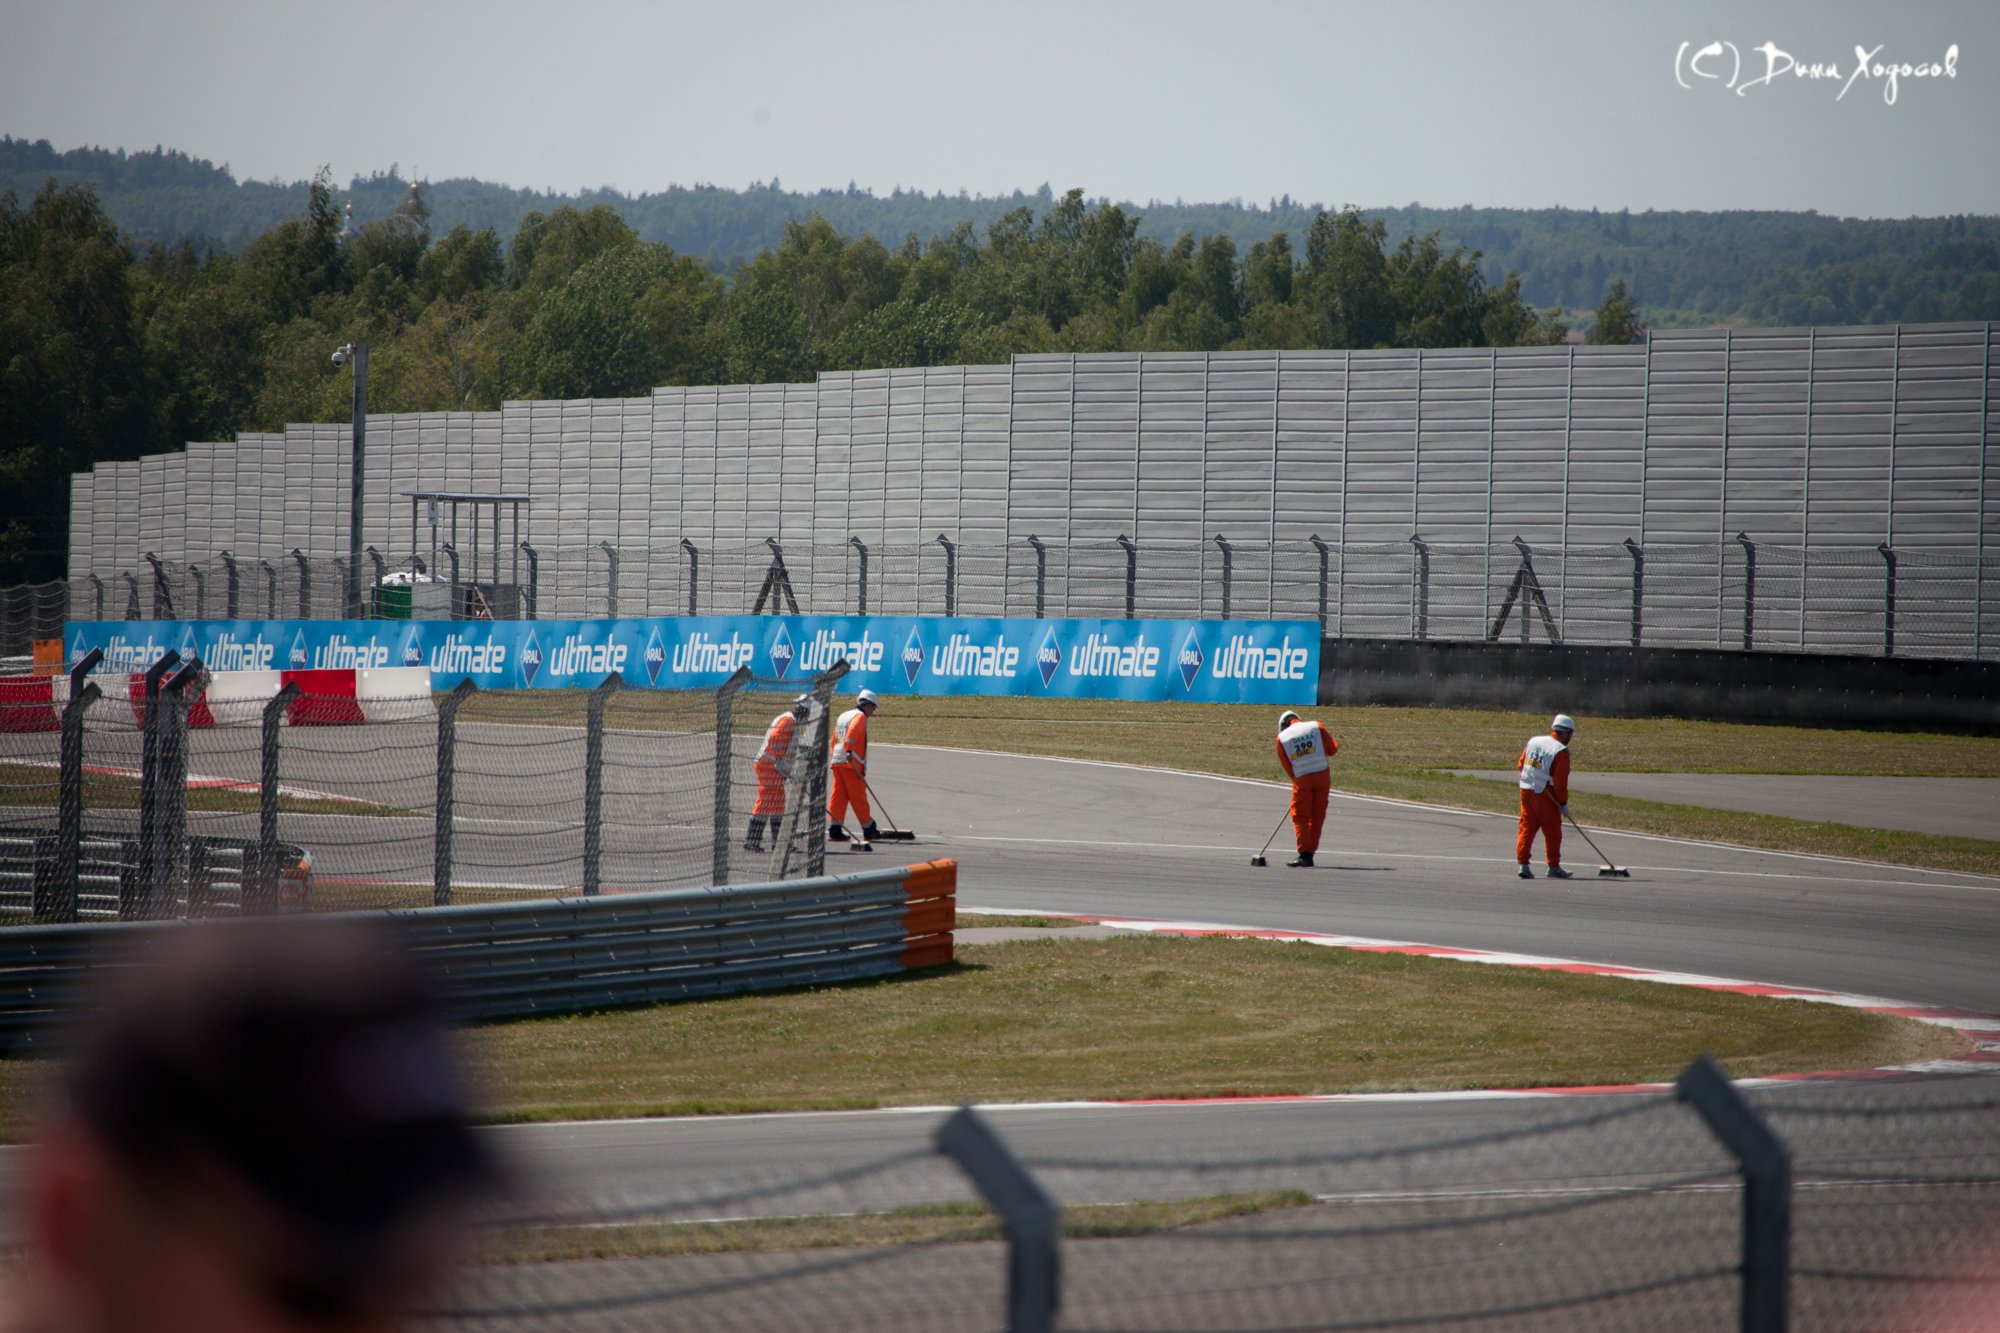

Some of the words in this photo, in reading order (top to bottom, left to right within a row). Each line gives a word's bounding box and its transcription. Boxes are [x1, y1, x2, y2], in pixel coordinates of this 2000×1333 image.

[204, 632, 274, 671] ultimate
[314, 634, 388, 670] ultimate
[404, 647, 419, 661] ARAL
[430, 634, 505, 673] ultimate
[523, 650, 539, 664] ARAL
[550, 634, 627, 676] ultimate
[647, 648, 663, 662] ARAL
[672, 631, 753, 673] ultimate
[773, 644, 791, 659] ARAL
[800, 629, 884, 672] ultimate
[904, 648, 922, 663] ARAL
[931, 634, 1019, 677] ultimate
[1039, 648, 1058, 663] ARAL
[1070, 633, 1160, 677] ultimate
[1179, 650, 1200, 666] ARAL
[1212, 634, 1308, 680] ultimate
